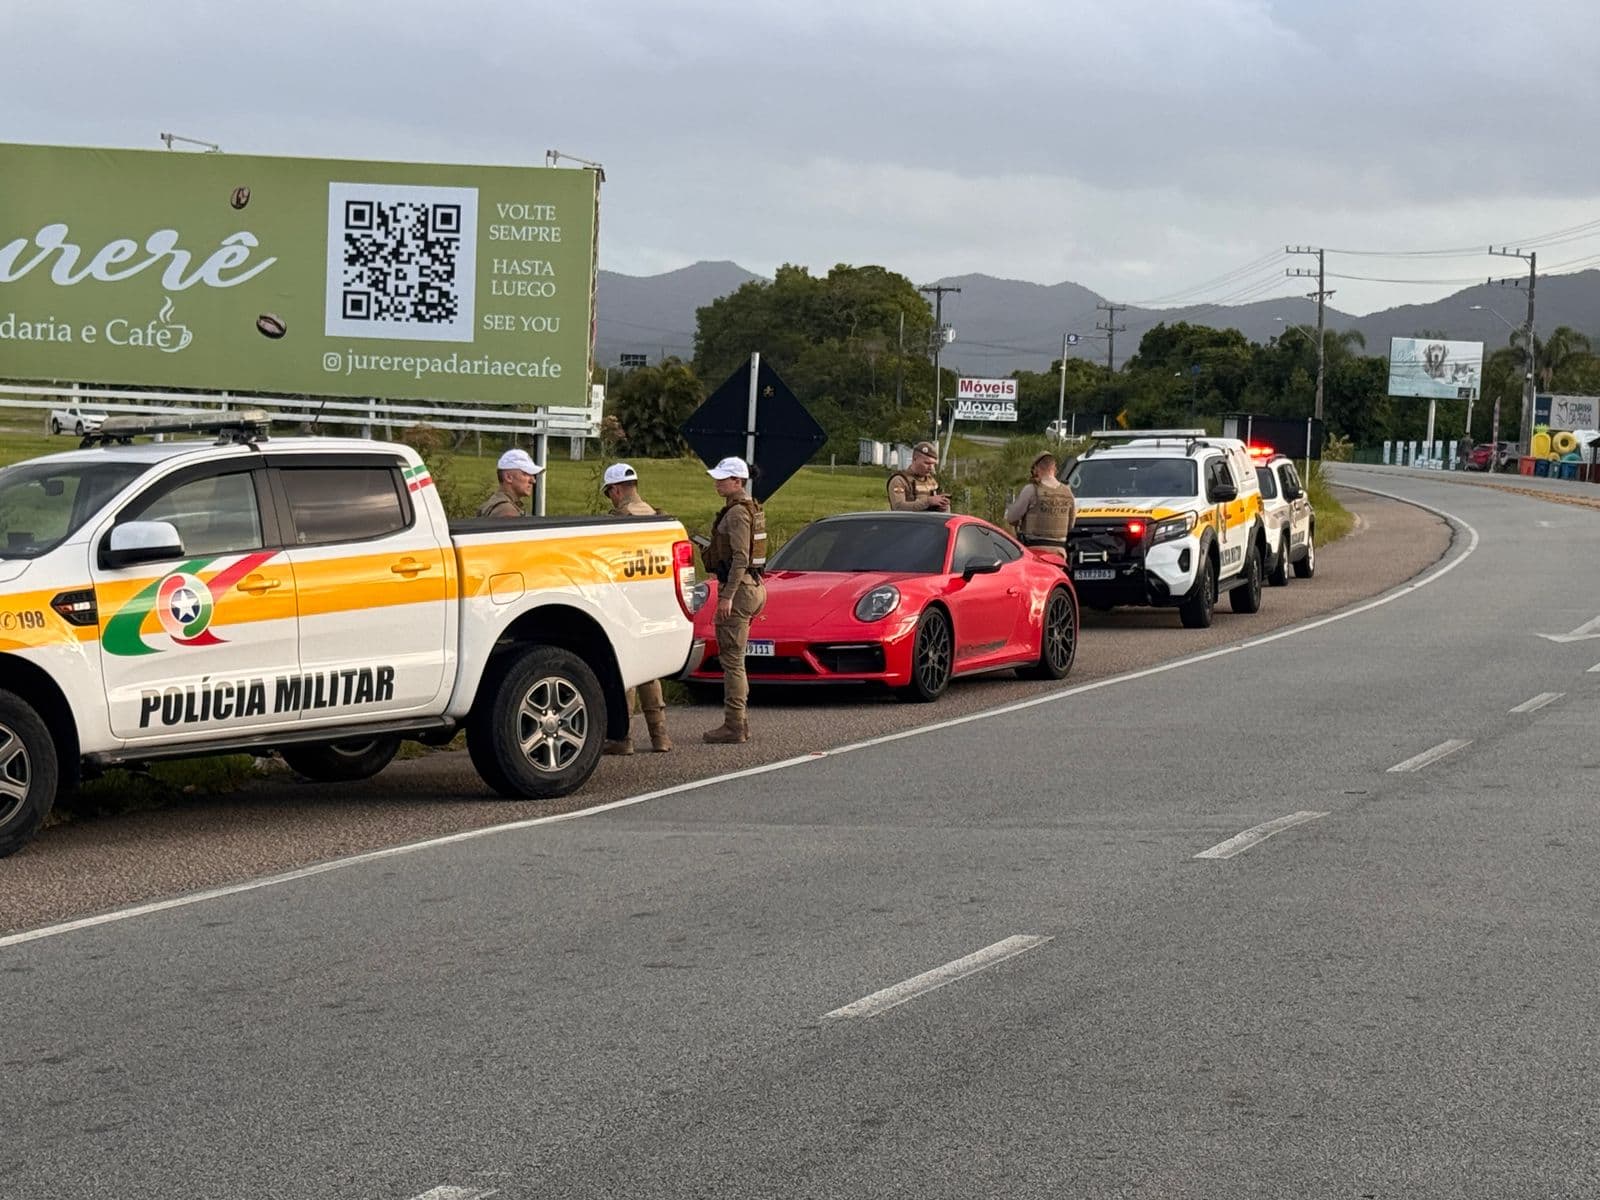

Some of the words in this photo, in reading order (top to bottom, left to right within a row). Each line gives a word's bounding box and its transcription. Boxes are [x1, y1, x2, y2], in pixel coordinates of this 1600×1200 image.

[496, 203, 557, 221] VOLTE
[489, 224, 562, 243] SEMPRE
[492, 258, 555, 277] HASTA
[491, 280, 556, 298] LUEGO
[81, 324, 97, 343] e
[483, 315, 516, 331] SEE
[520, 316, 561, 333] YOU
[346, 349, 562, 379] jurerepadariaecafe
[960, 380, 1014, 393] Móveis
[16, 610, 45, 629] 198
[138, 676, 267, 729] POLÍCIA
[273, 665, 396, 714] MILITAR
